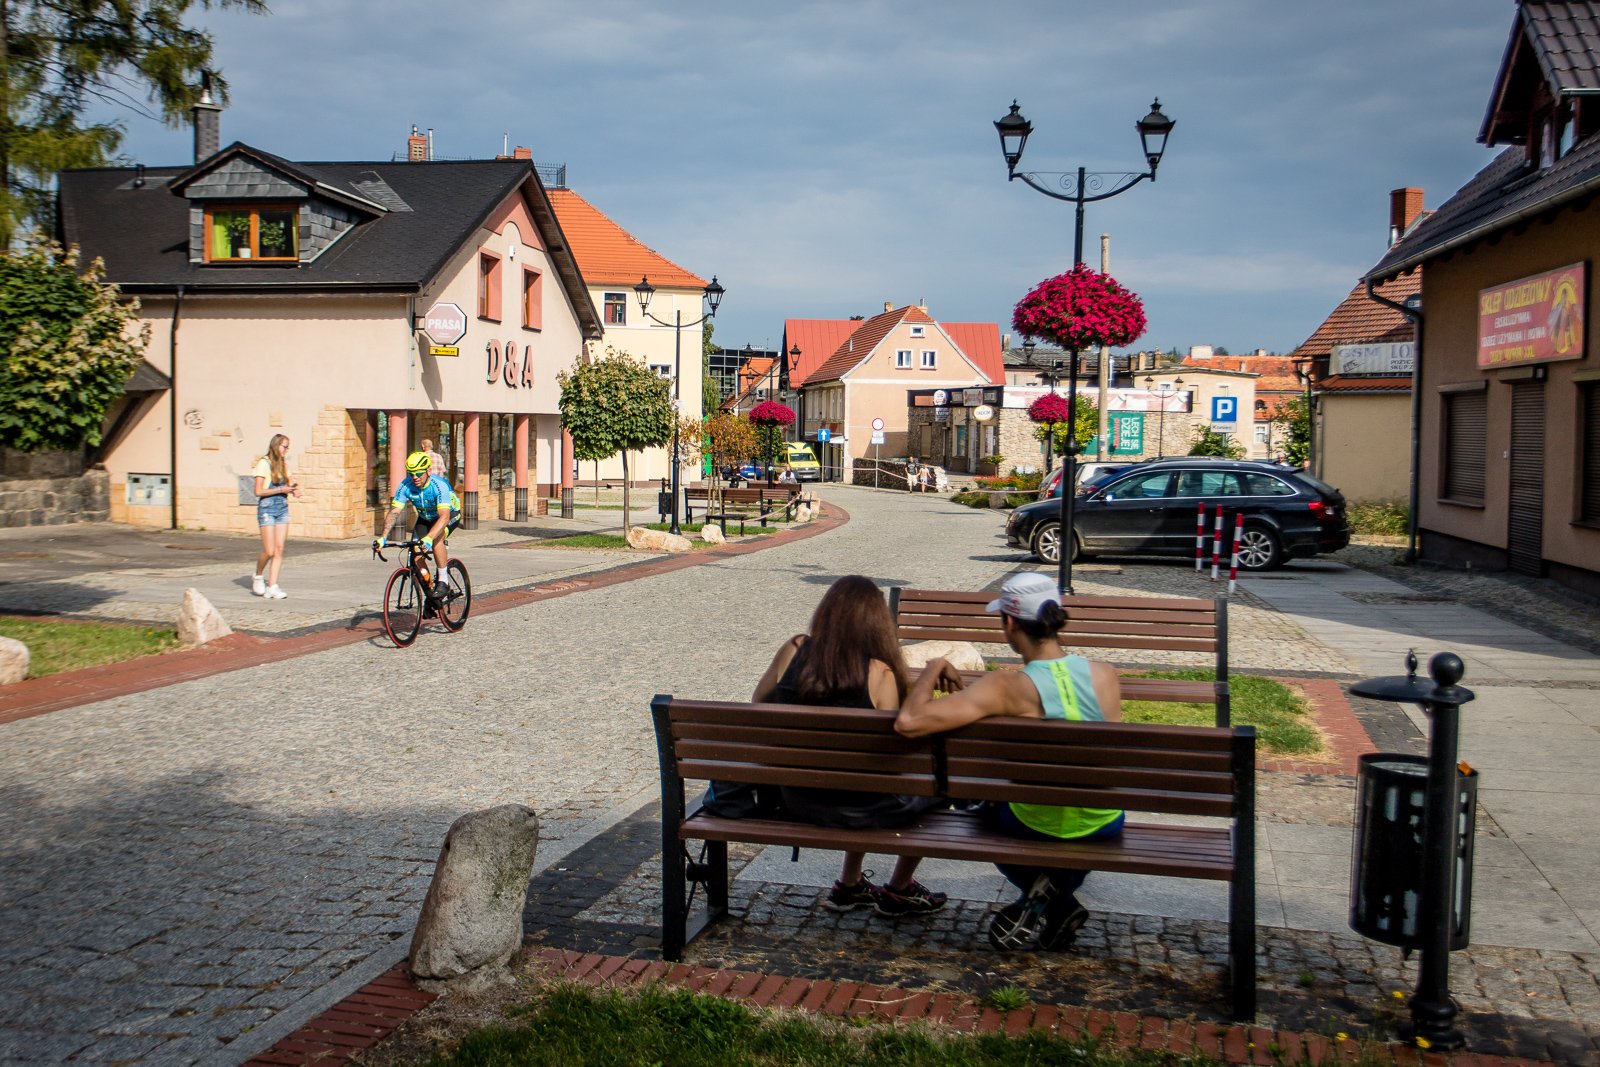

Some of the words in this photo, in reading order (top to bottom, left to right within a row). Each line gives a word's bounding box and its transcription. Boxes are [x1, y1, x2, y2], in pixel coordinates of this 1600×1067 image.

[1481, 292, 1501, 315] SKLEP
[428, 319, 460, 330] PRASA
[1338, 347, 1382, 358] GSM
[486, 338, 534, 389] D&A
[1216, 399, 1233, 419] P
[1130, 417, 1140, 437] LECH
